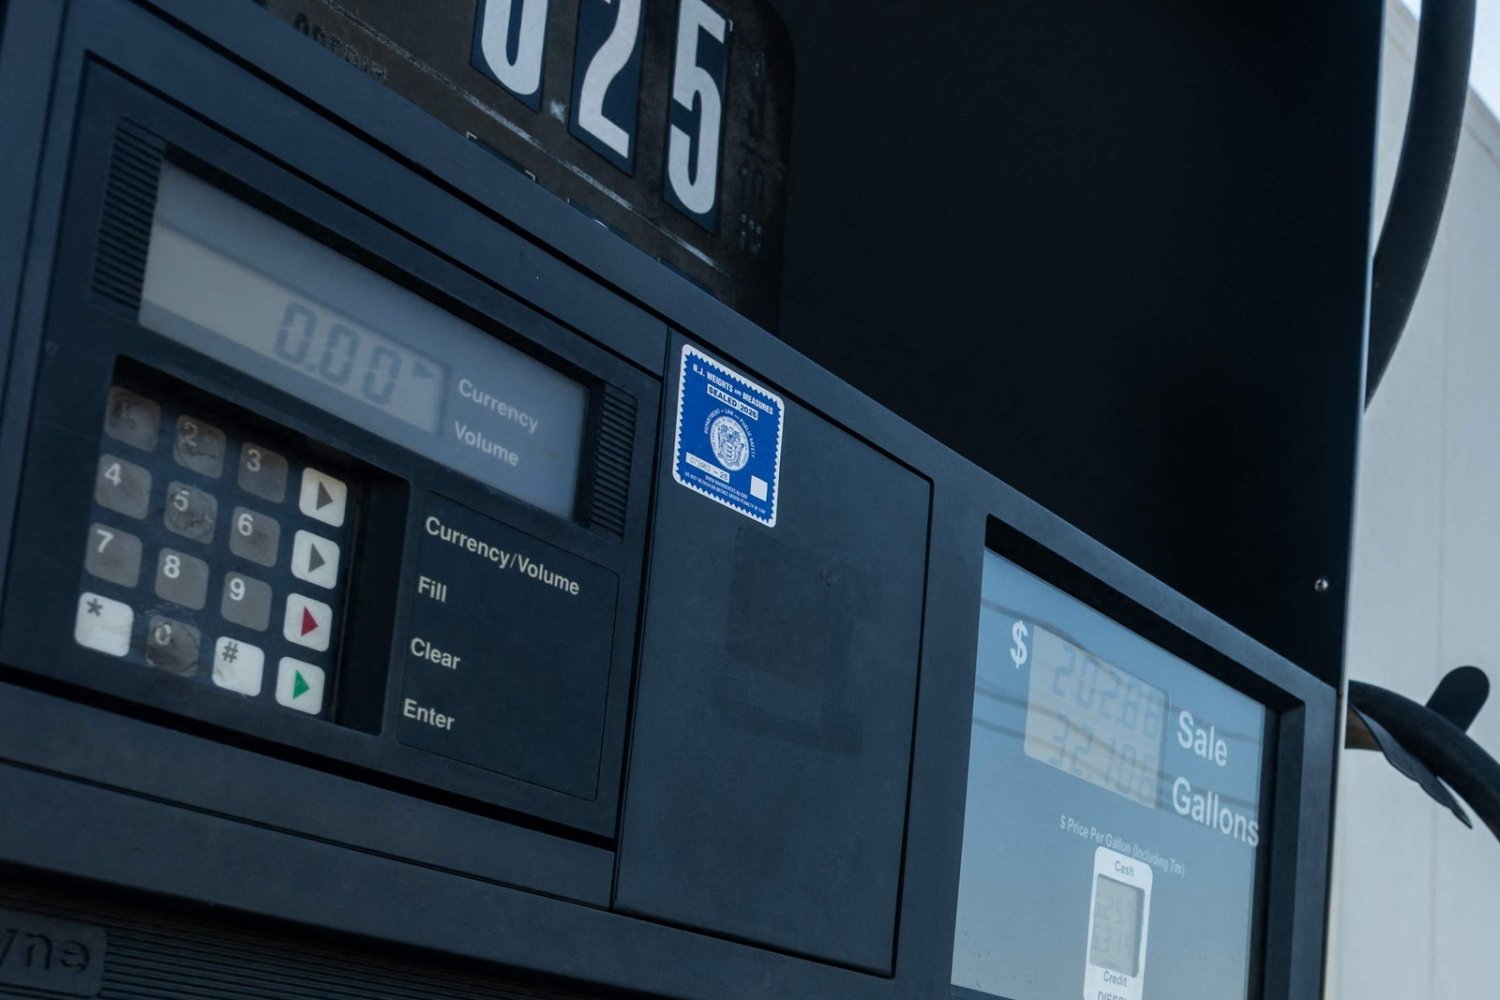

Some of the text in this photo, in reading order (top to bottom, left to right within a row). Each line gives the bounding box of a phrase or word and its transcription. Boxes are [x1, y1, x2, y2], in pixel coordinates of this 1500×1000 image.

[273, 302, 402, 405] 0.00
[458, 378, 539, 435] Currency
[707, 371, 734, 393] WEIGHTS
[743, 392, 773, 415] MEASURES
[708, 386, 737, 407] SEALED
[180, 422, 198, 447] 2
[247, 449, 262, 473] 3
[454, 421, 520, 467] Volume
[104, 463, 254, 537] 4 5 6
[96, 529, 246, 602] 7 8 9
[425, 516, 580, 596] Currency/Volume
[417, 575, 447, 603] Fill
[410, 637, 461, 670] Clear
[403, 698, 455, 730] Enter
[1010, 620, 1028, 668] $
[1177, 710, 1228, 767] Sale
[1172, 777, 1260, 848] Gallons
[1067, 818, 1089, 838] Price
[1090, 826, 1105, 843] Per
[1106, 833, 1131, 855] Gallon
[1132, 844, 1169, 873] (Including
[1114, 860, 1135, 878] Cash
[1103, 970, 1127, 988] Credit
